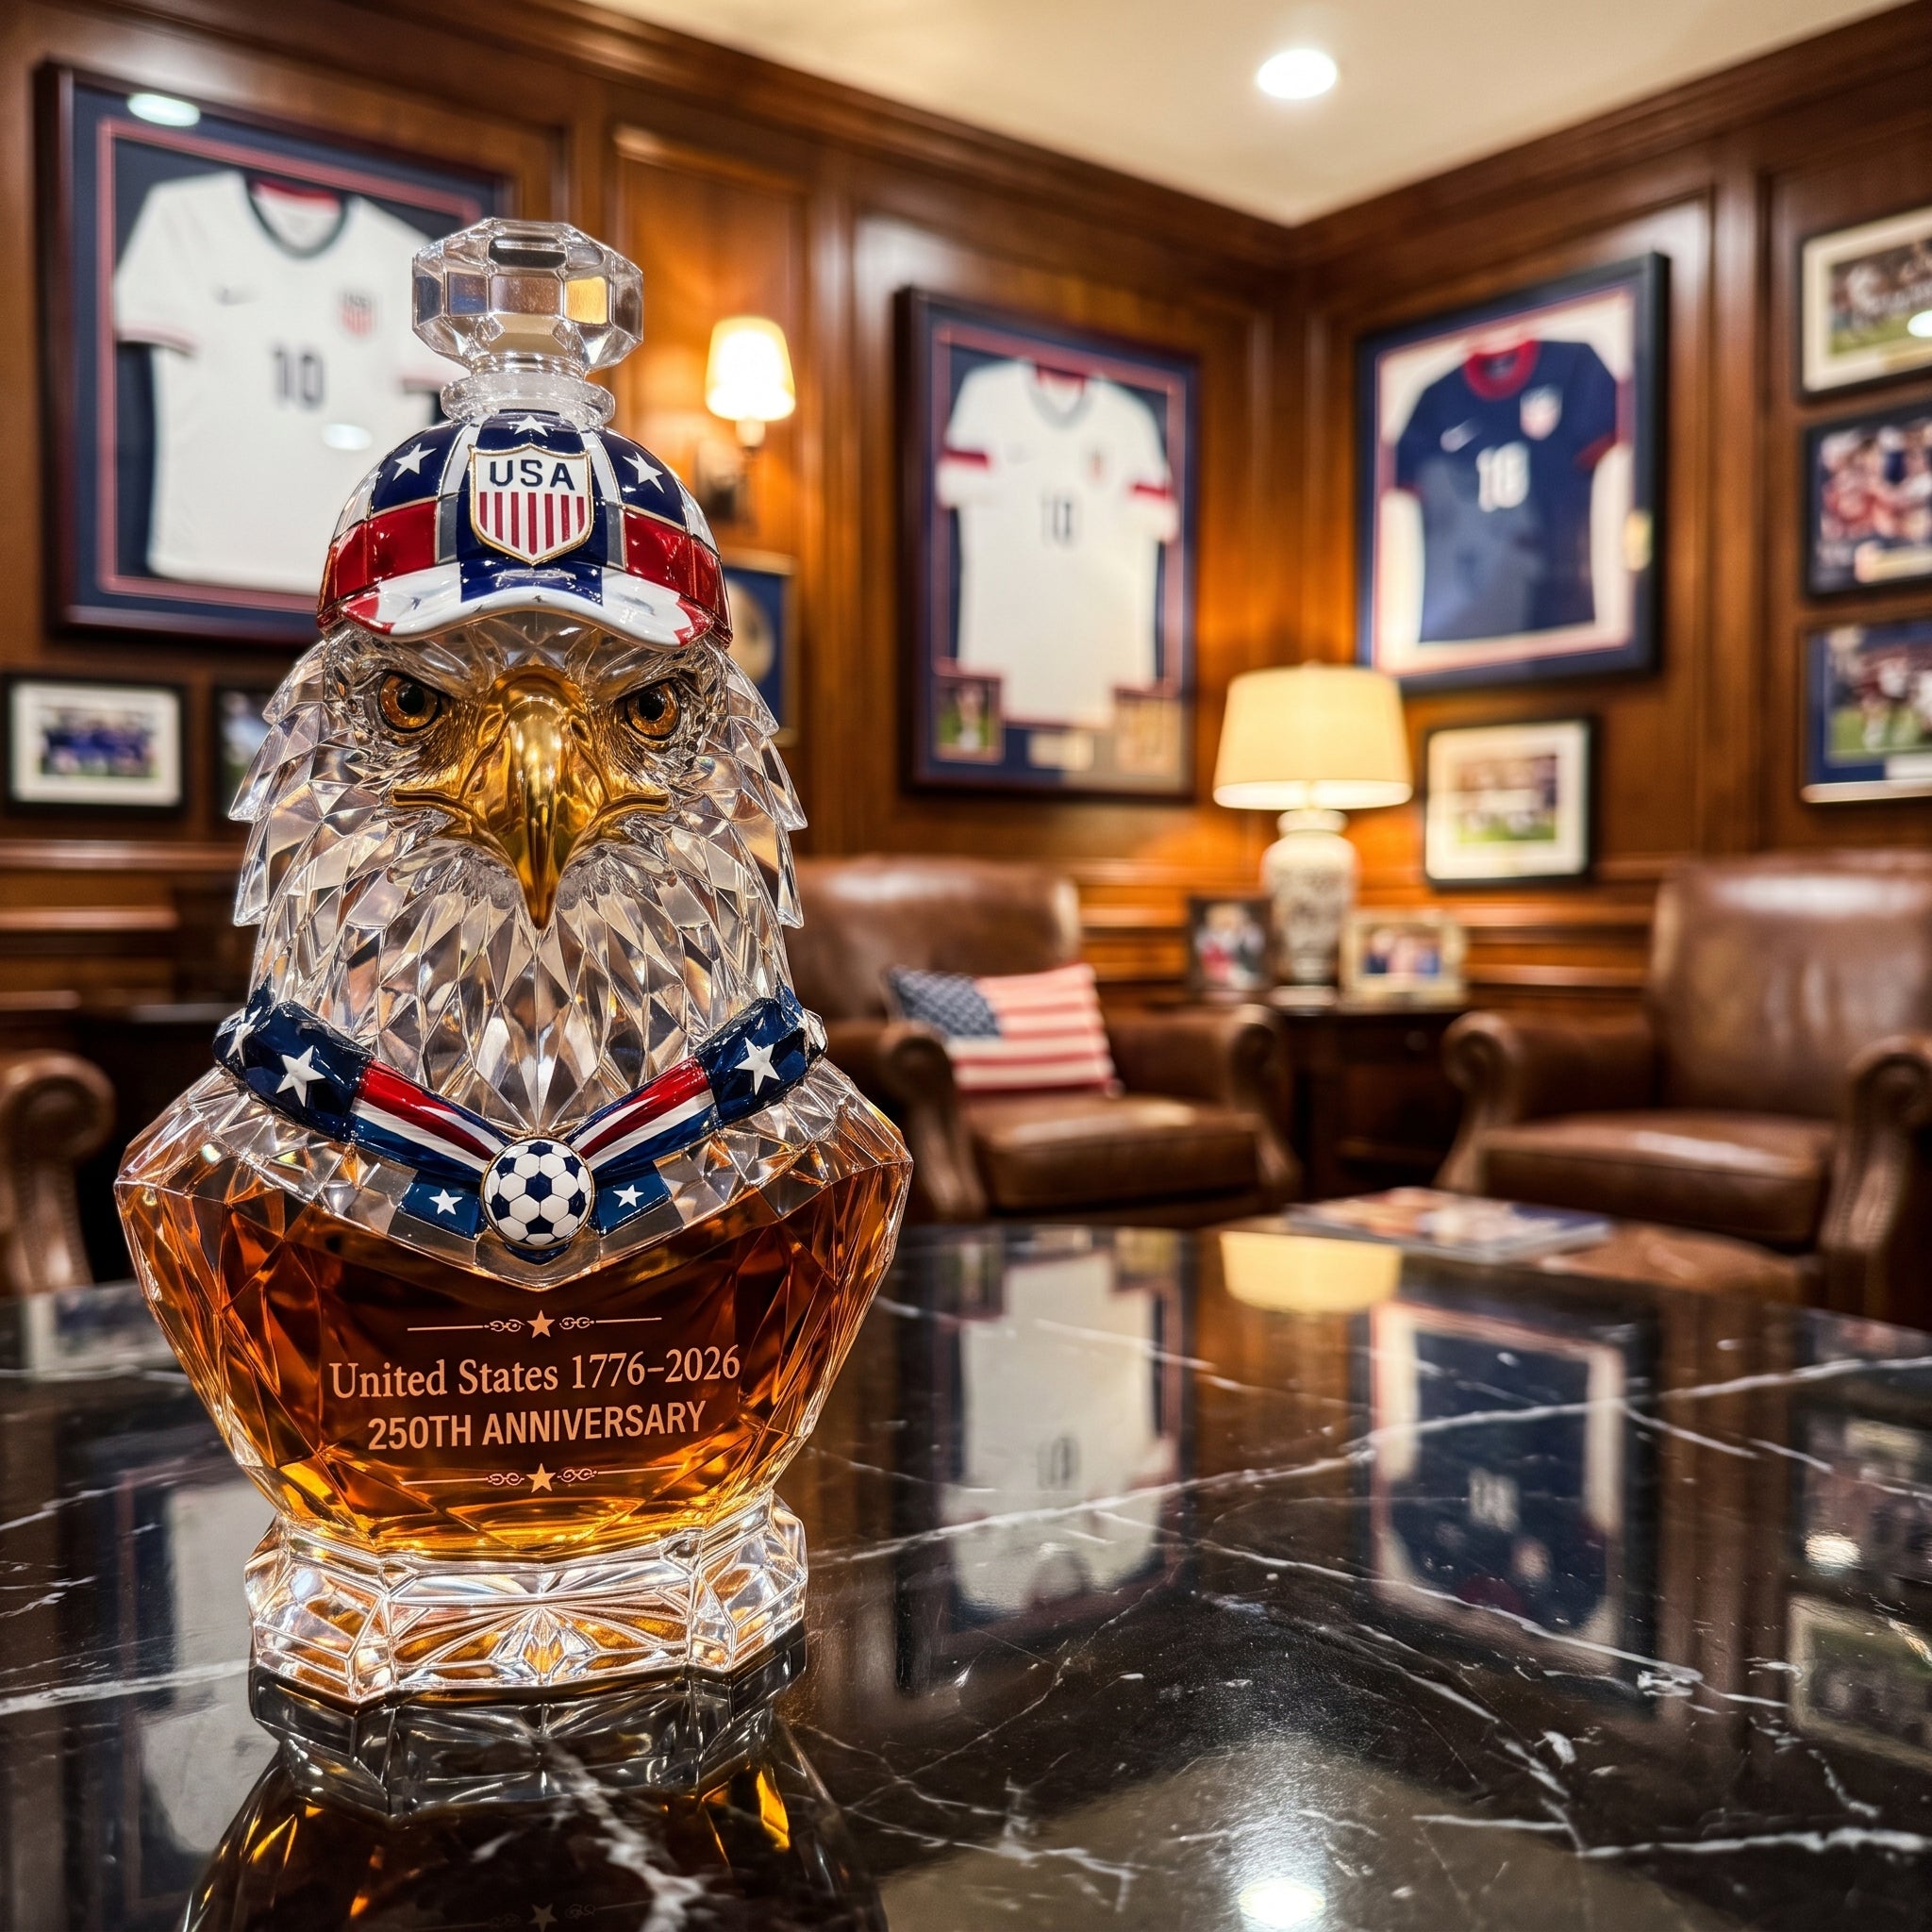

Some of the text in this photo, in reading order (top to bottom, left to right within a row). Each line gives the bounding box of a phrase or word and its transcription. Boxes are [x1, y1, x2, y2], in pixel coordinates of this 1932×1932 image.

[272, 344, 325, 409] 10
[489, 459, 575, 491] USA
[328, 1358, 448, 1398] United
[458, 1358, 558, 1395] States
[368, 1400, 707, 1450] 250TH ANNIVERSARY
